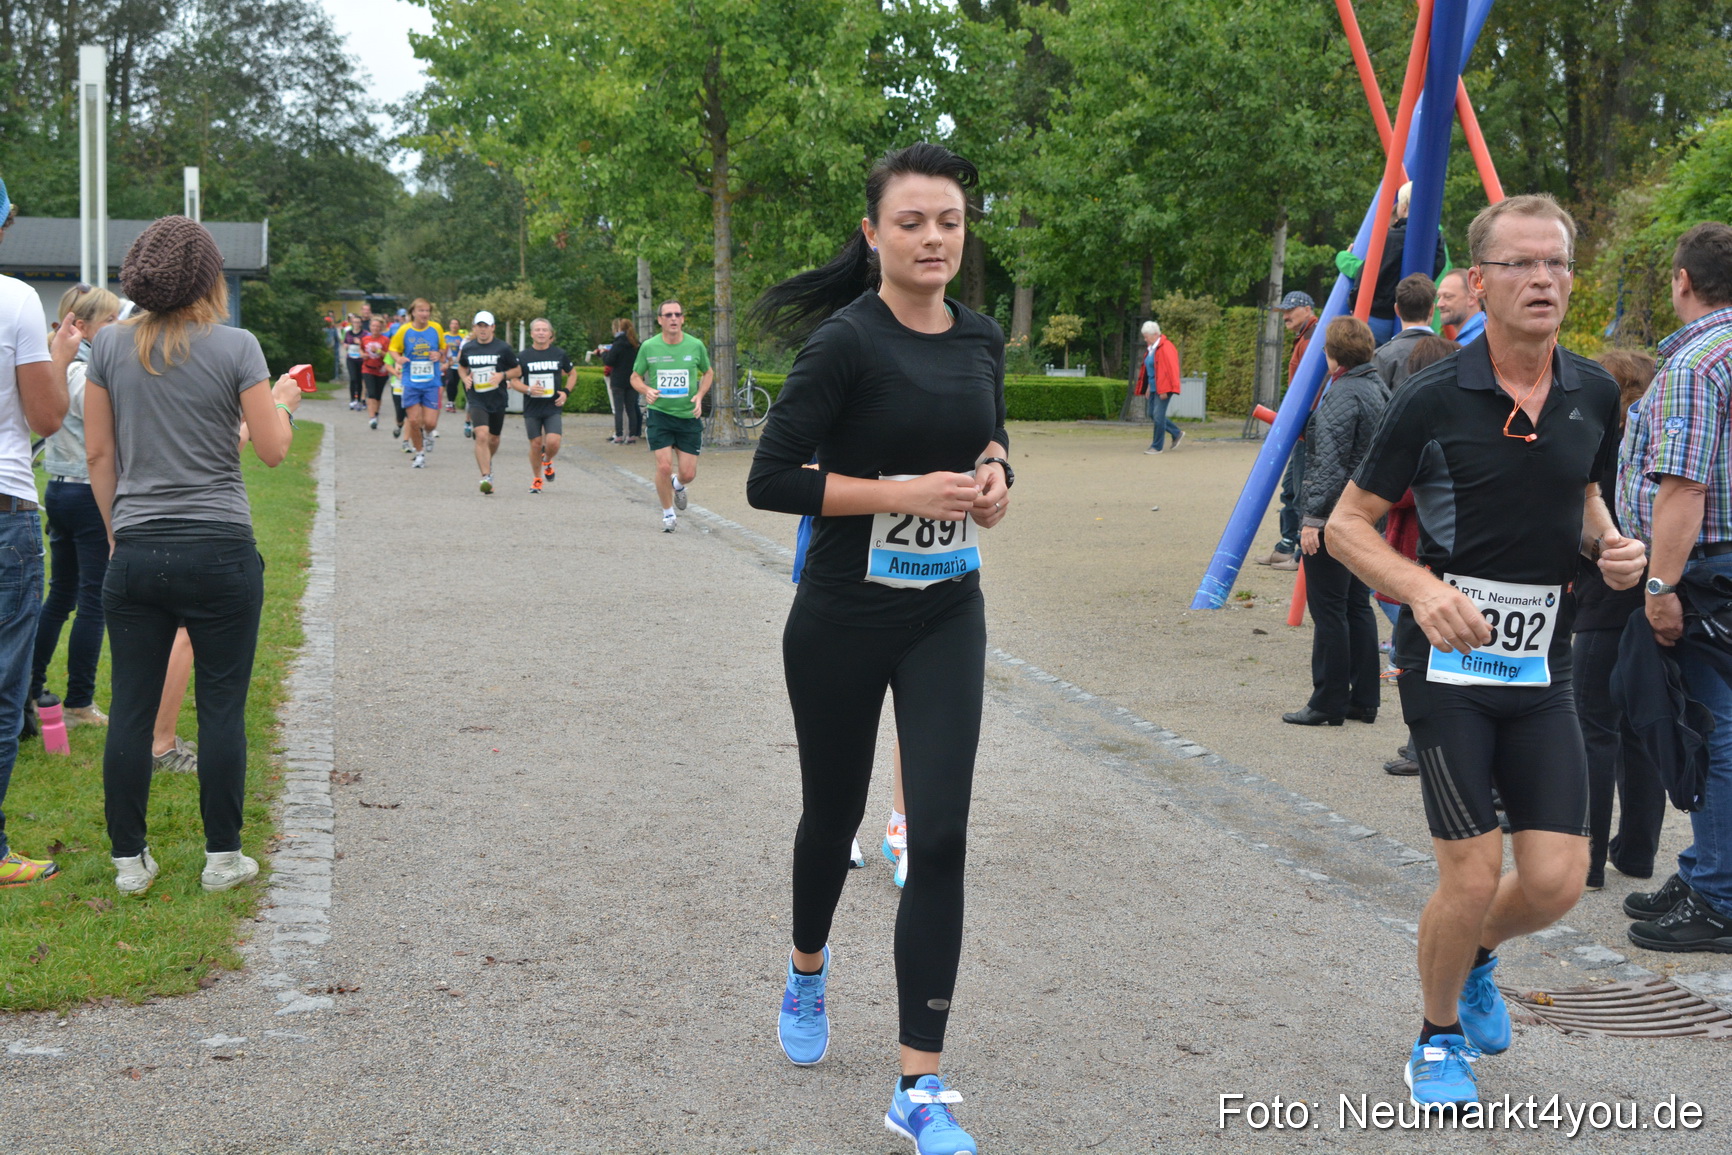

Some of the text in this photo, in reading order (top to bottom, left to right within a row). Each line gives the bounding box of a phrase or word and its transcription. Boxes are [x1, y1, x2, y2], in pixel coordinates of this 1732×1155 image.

[660, 376, 686, 387] 2729
[885, 511, 968, 548] 2891
[888, 556, 967, 576] Annamaria
[1455, 586, 1542, 606] RTL Neumarkt
[1462, 655, 1521, 677] Günther
